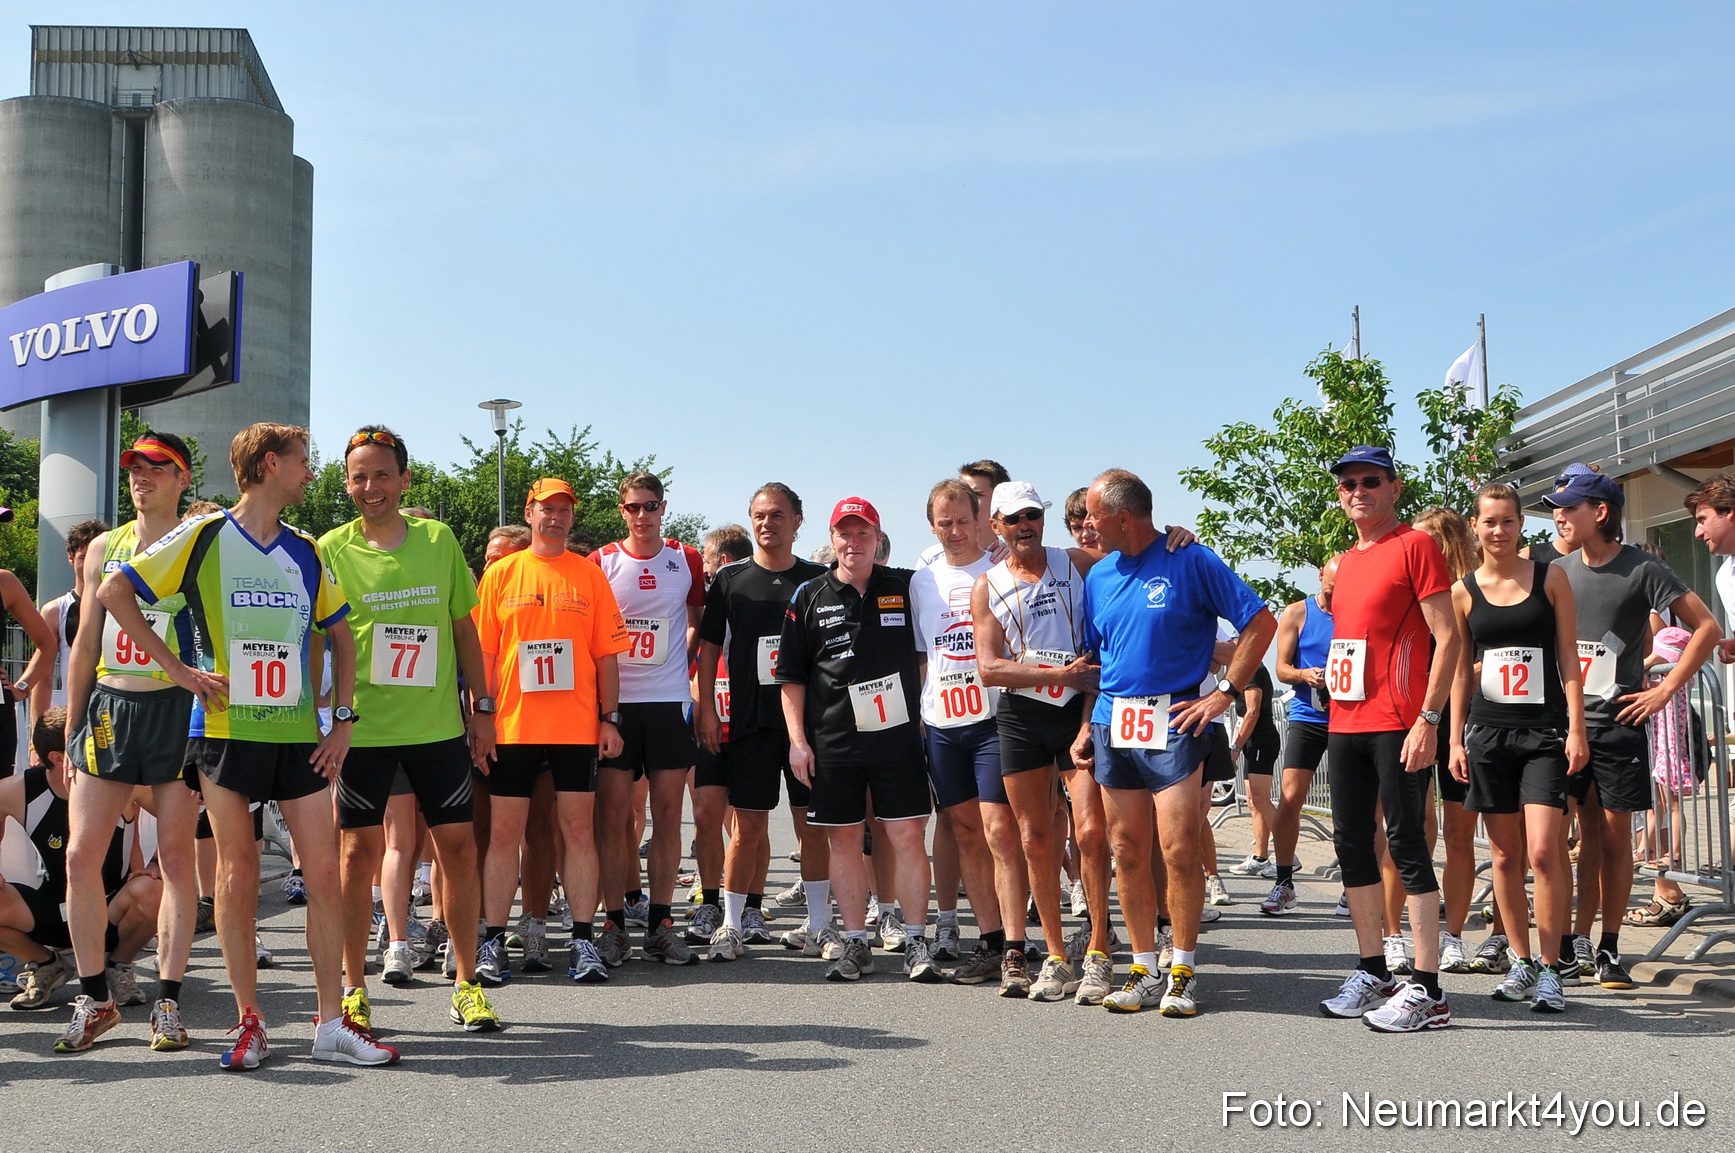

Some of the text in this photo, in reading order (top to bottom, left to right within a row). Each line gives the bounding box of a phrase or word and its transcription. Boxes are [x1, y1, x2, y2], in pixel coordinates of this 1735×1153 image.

[9, 303, 159, 367] VOLVO
[232, 577, 279, 589] TEAM
[231, 590, 299, 609] BOCK
[362, 586, 437, 603] GESUNDHEIT
[381, 601, 409, 610] BESTEN
[941, 609, 971, 620] SEA
[384, 627, 415, 635] MEYER
[242, 643, 275, 651] MEYER
[527, 642, 552, 650] MEYER
[628, 631, 655, 659] 79
[390, 643, 421, 678] 77
[1035, 651, 1063, 660] MEYER
[1035, 656, 1063, 665] WERBUNG
[251, 660, 286, 698] 10
[534, 656, 555, 685] 11
[940, 672, 963, 682] MEYER
[1331, 658, 1352, 693] 58
[859, 681, 883, 692] MEYER
[1499, 664, 1529, 696] 12
[873, 694, 887, 723] 1
[940, 685, 983, 718] 100
[1121, 707, 1154, 742] 85
